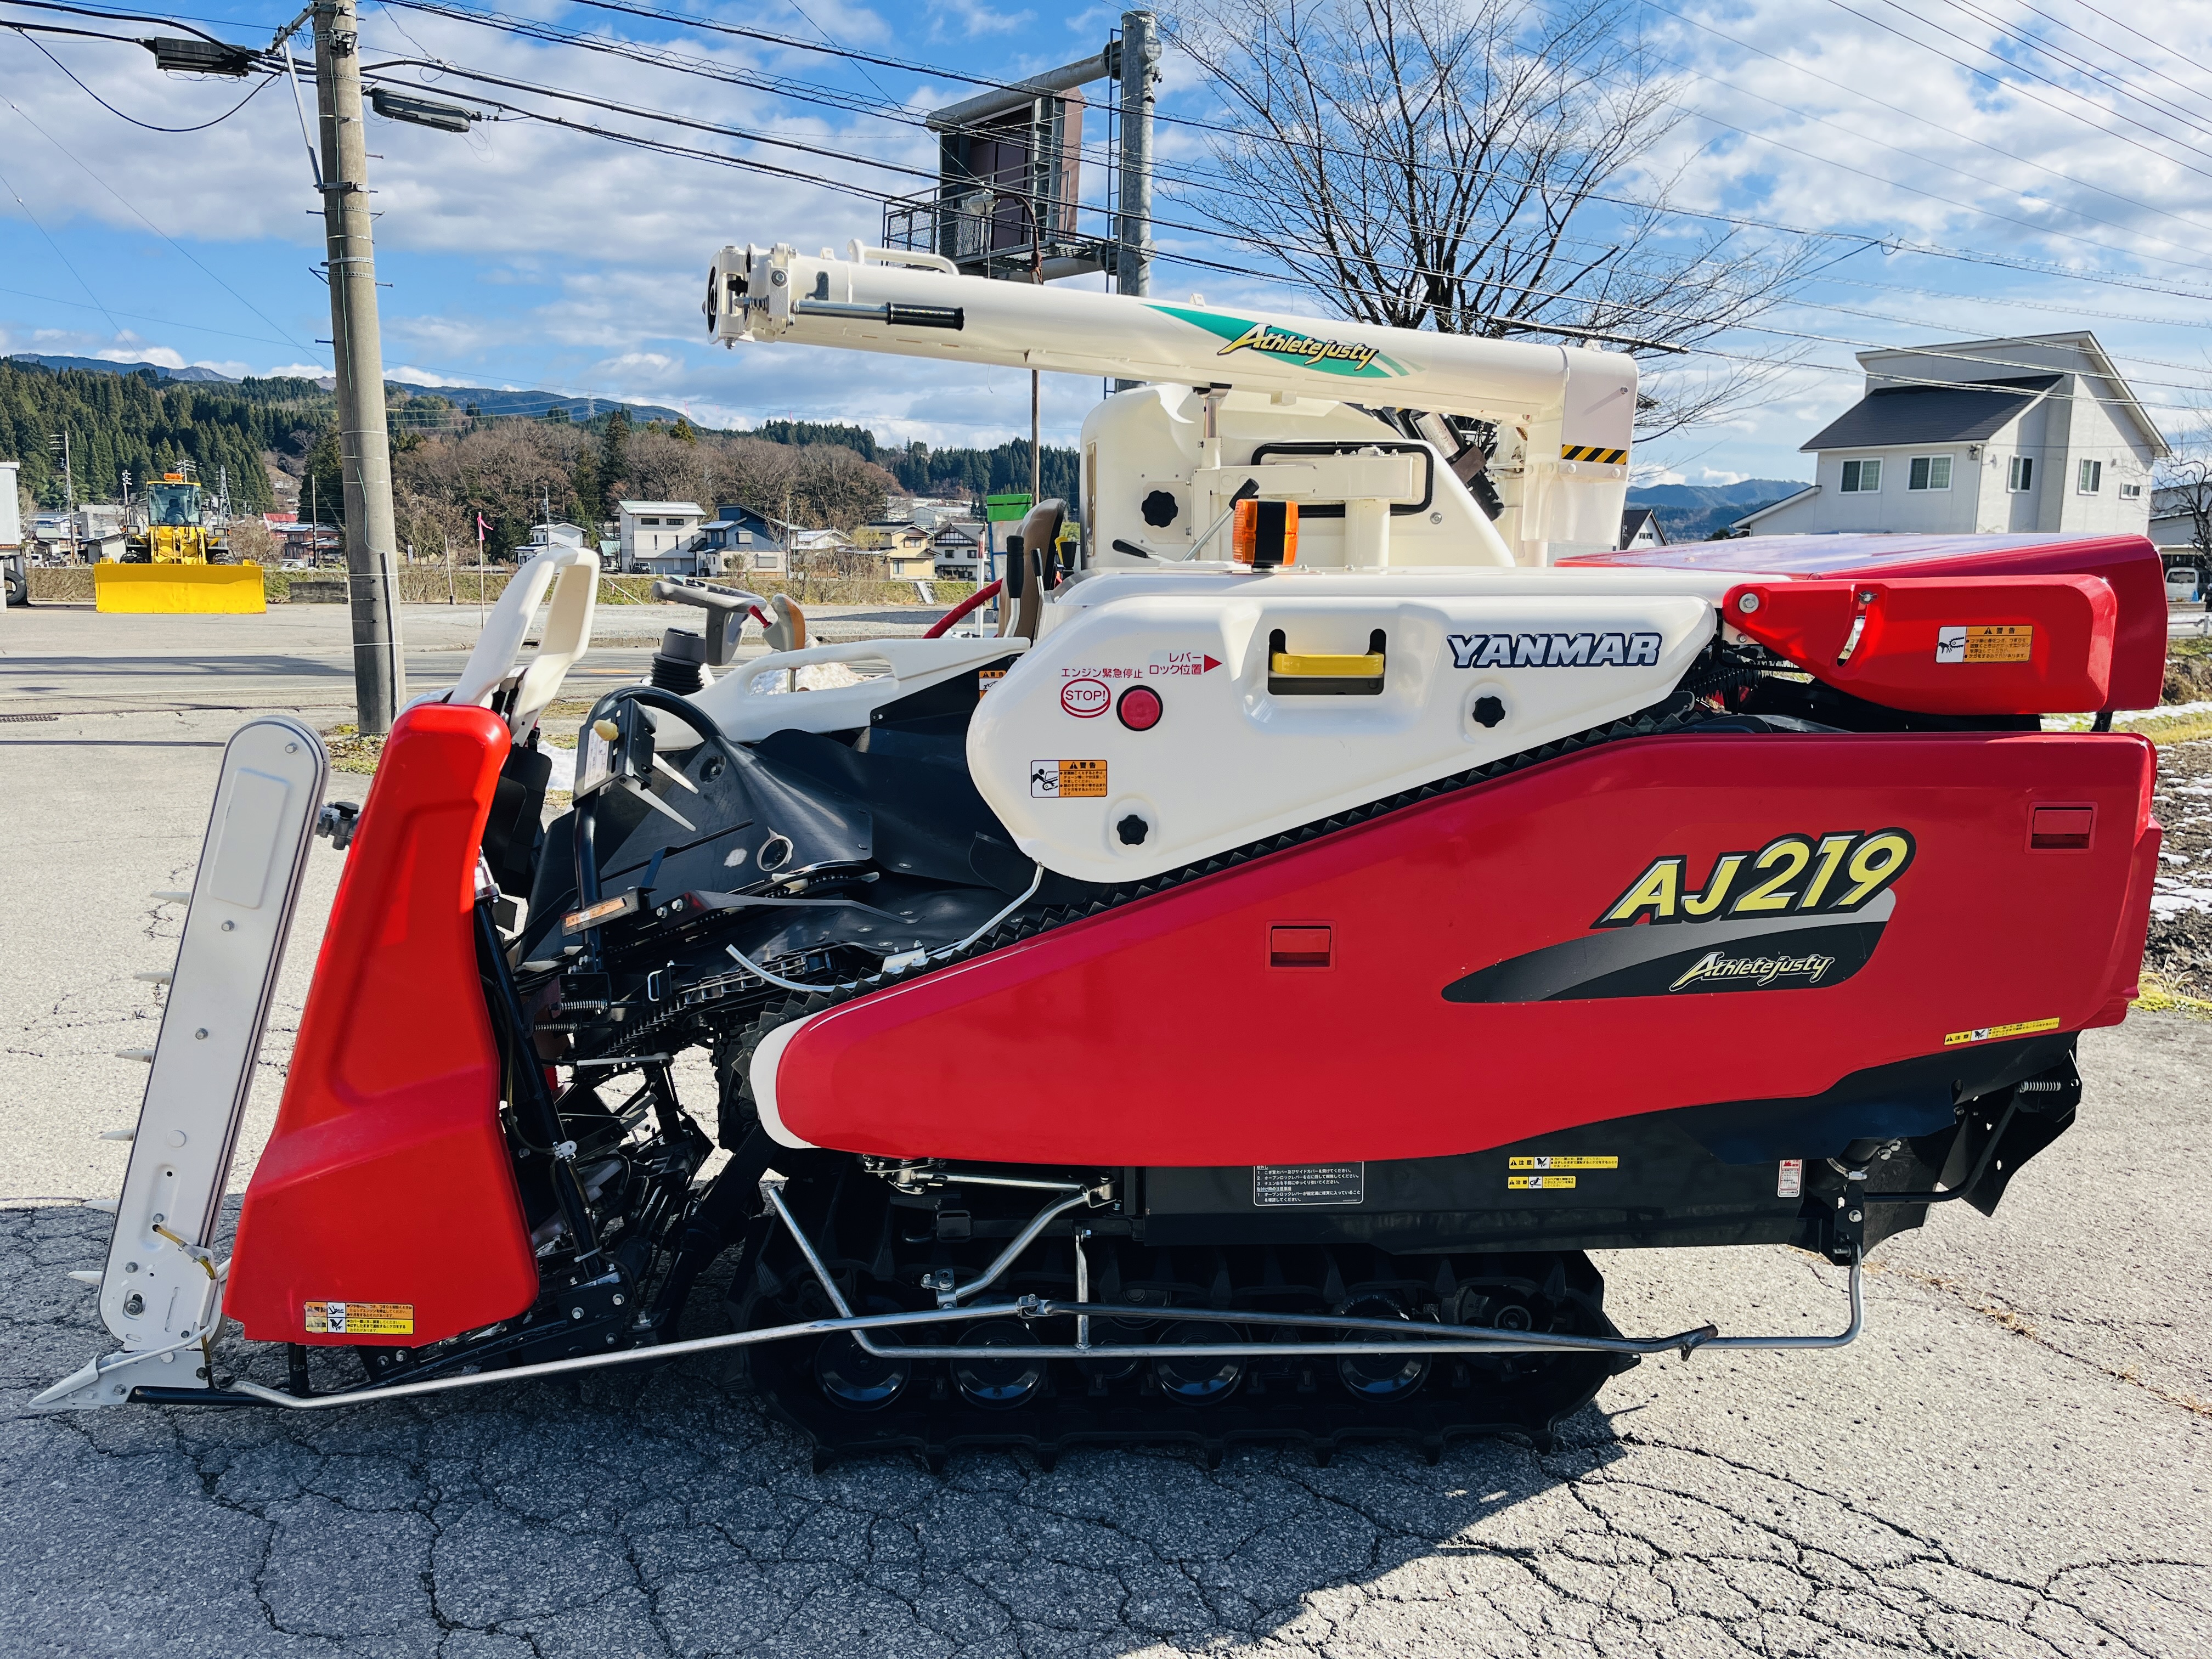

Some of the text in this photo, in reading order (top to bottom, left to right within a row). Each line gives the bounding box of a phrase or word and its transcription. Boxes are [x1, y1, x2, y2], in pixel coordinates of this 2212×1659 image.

[1217, 323, 1379, 370] Athletejusty
[1170, 652, 1201, 663] レバー
[1447, 633, 1662, 668] YANMAR
[1062, 668, 1143, 679] エンジン緊急停止
[1150, 664, 1201, 675] ロック位置
[1065, 690, 1106, 701] STOP!
[1590, 829, 1915, 928] AJ219
[1669, 952, 1835, 992] Athletejusty
